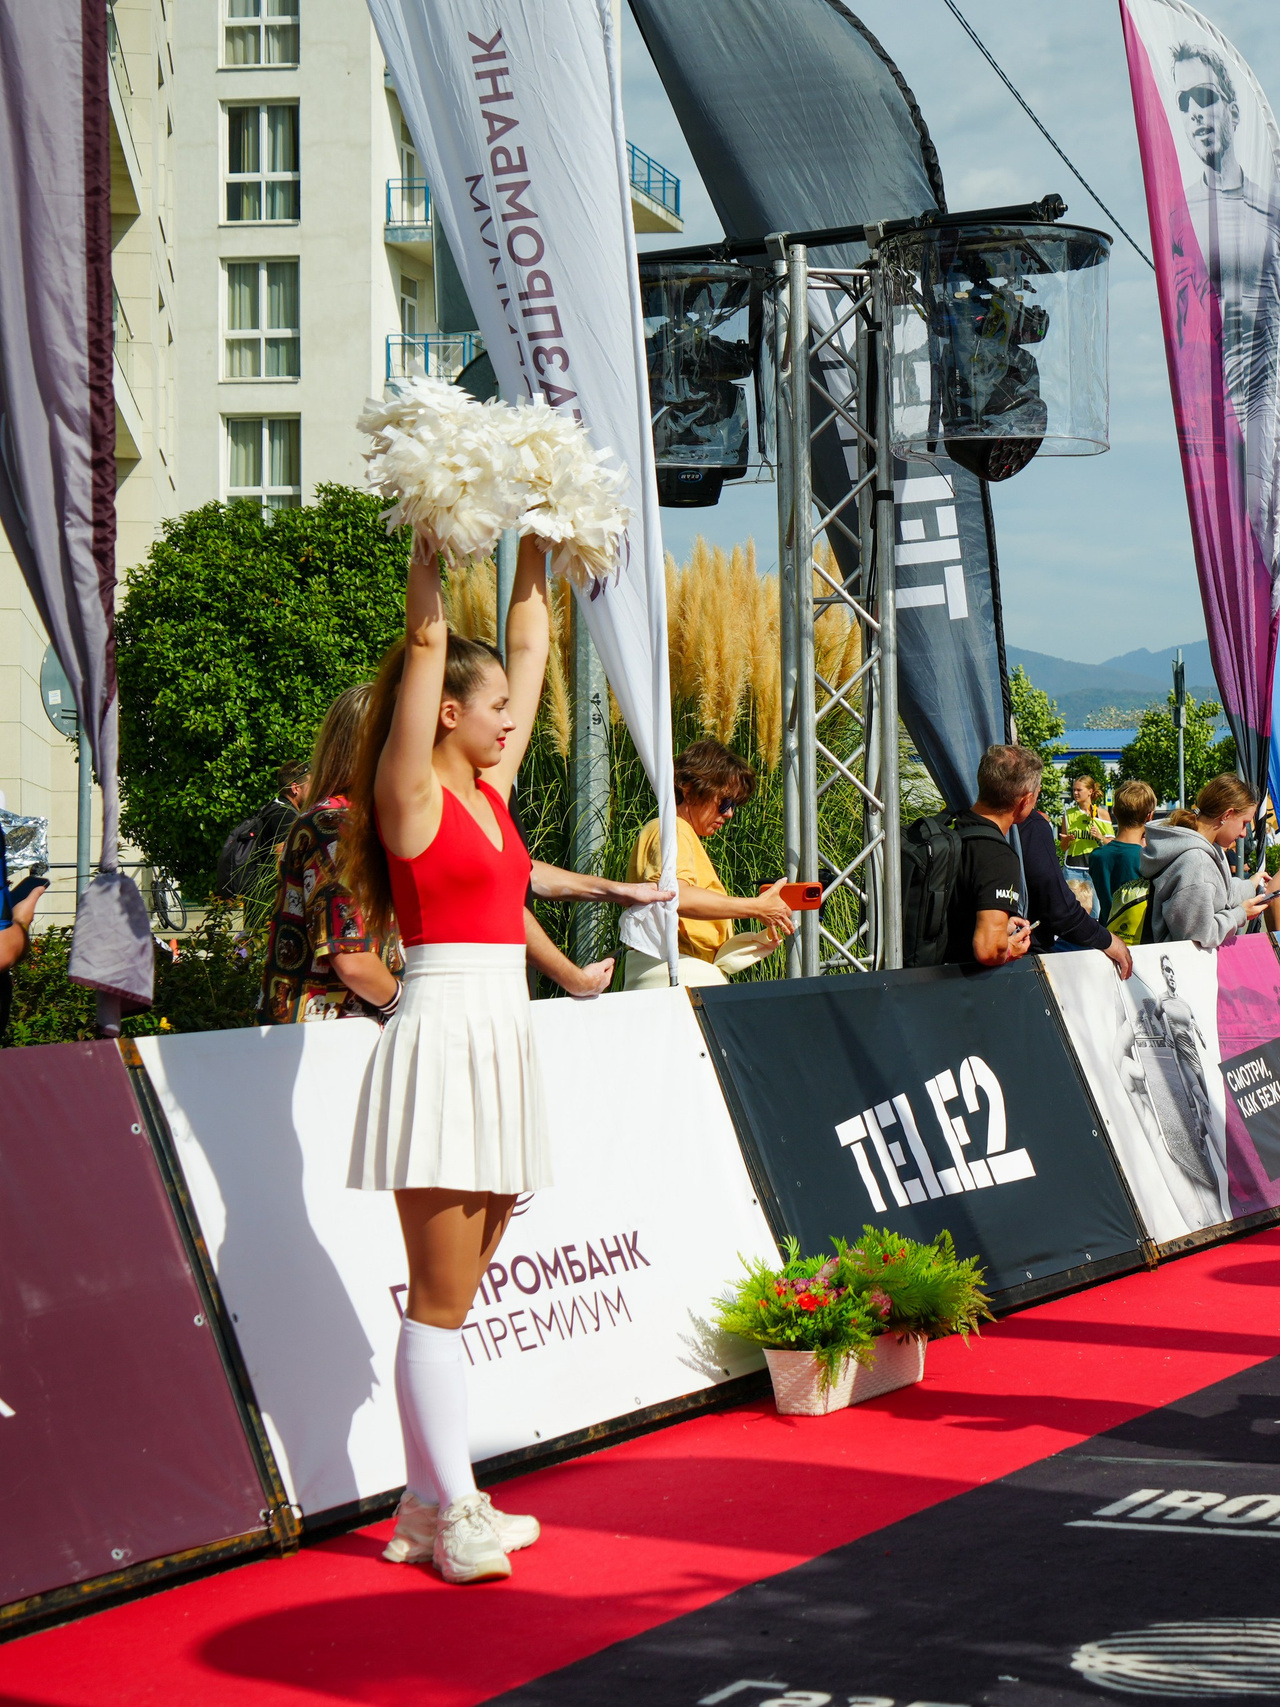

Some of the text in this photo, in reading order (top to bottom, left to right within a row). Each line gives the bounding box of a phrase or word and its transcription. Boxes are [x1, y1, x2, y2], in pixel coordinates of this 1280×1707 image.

[1226, 1057, 1273, 1092] СМОТРИ,
[1236, 1091, 1262, 1118] КАК
[835, 1055, 1037, 1213] TELE2
[389, 1230, 651, 1322] ГПРОМБАНК
[461, 1285, 632, 1366] ПРЕМИУМ
